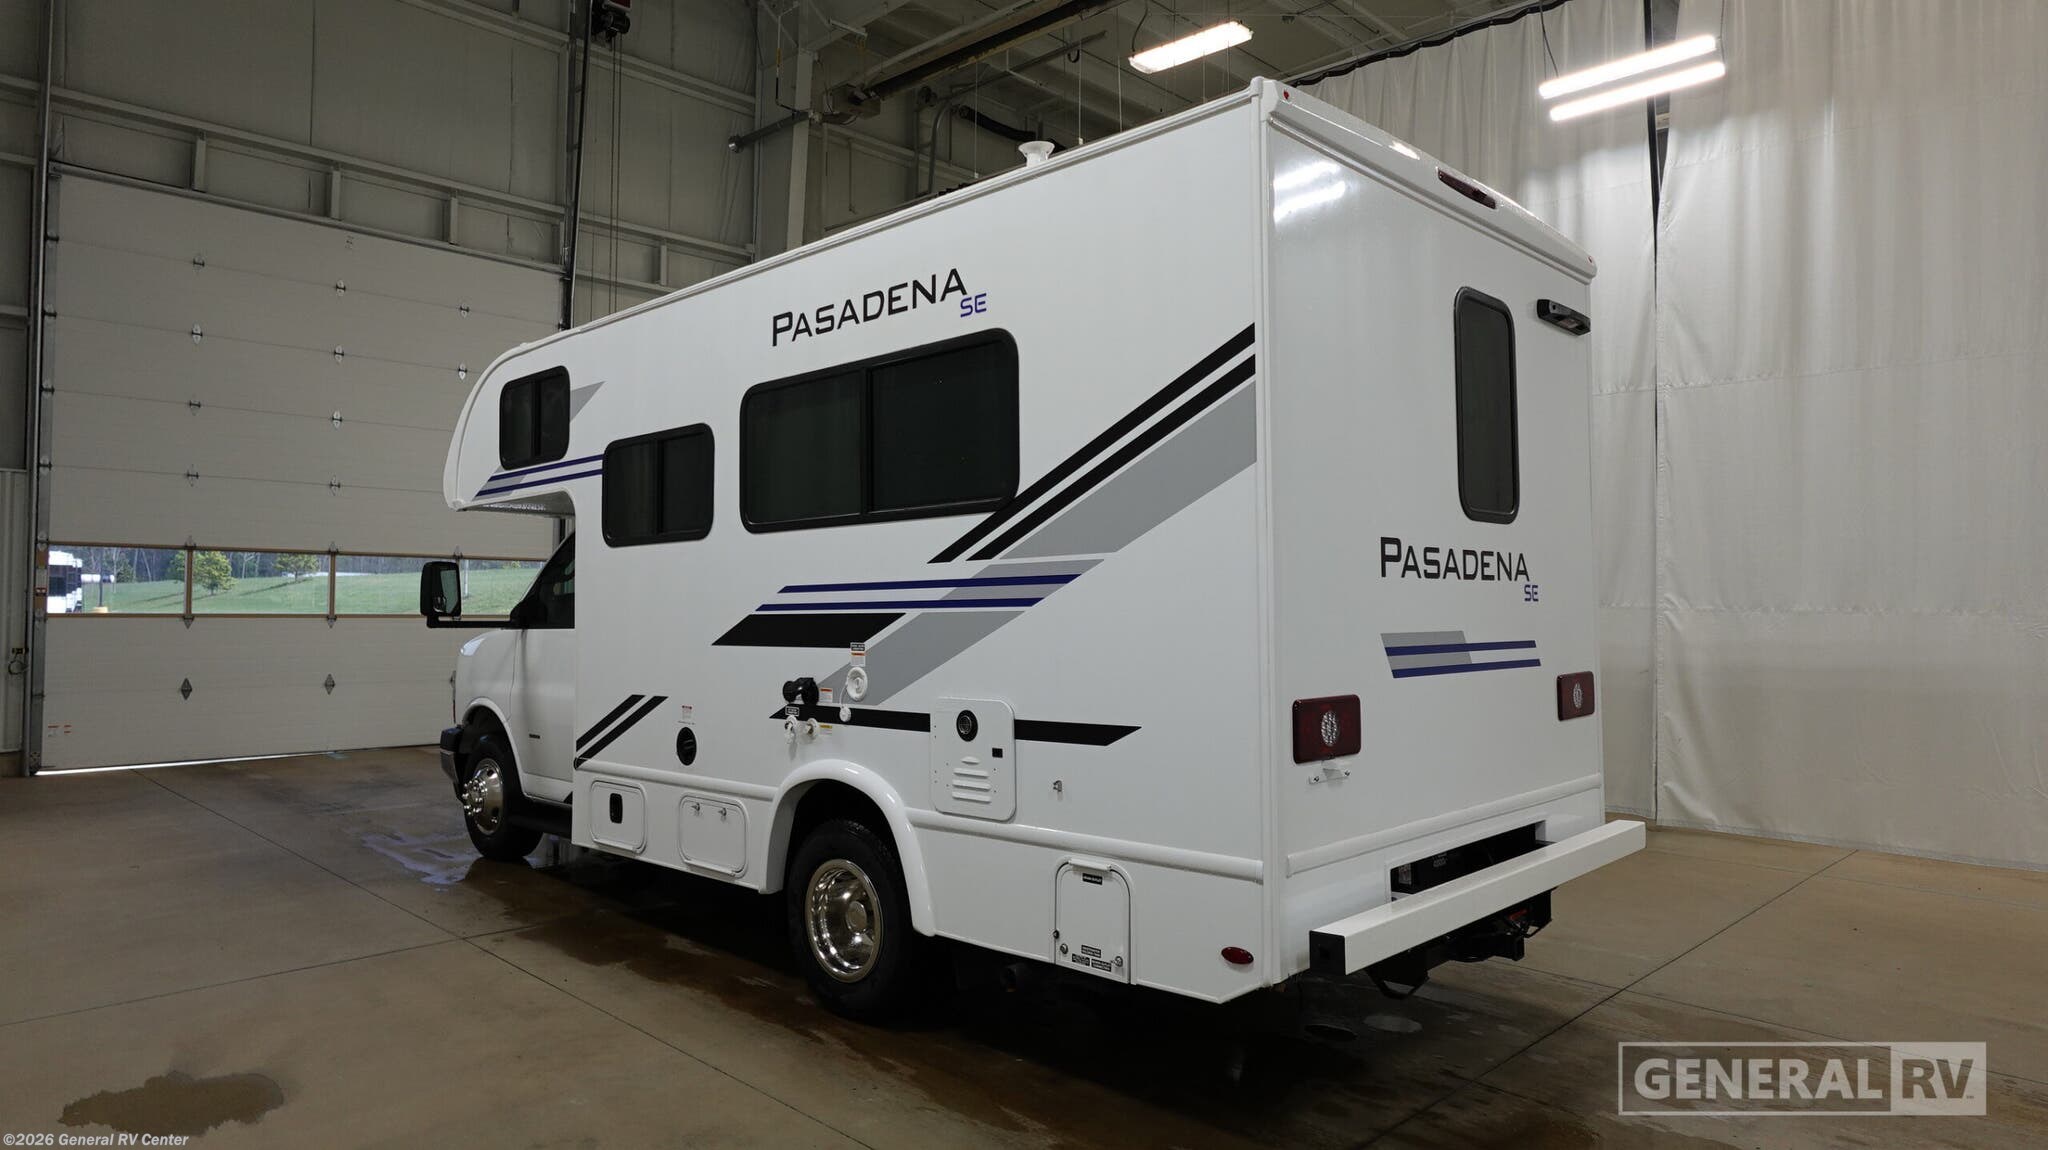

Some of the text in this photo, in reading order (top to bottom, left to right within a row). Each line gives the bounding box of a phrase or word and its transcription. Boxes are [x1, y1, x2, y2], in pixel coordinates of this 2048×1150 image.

[772, 268, 968, 347] PASADENA
[960, 293, 987, 318] SE
[1380, 536, 1530, 582] PASADENA
[1524, 584, 1539, 602] SE
